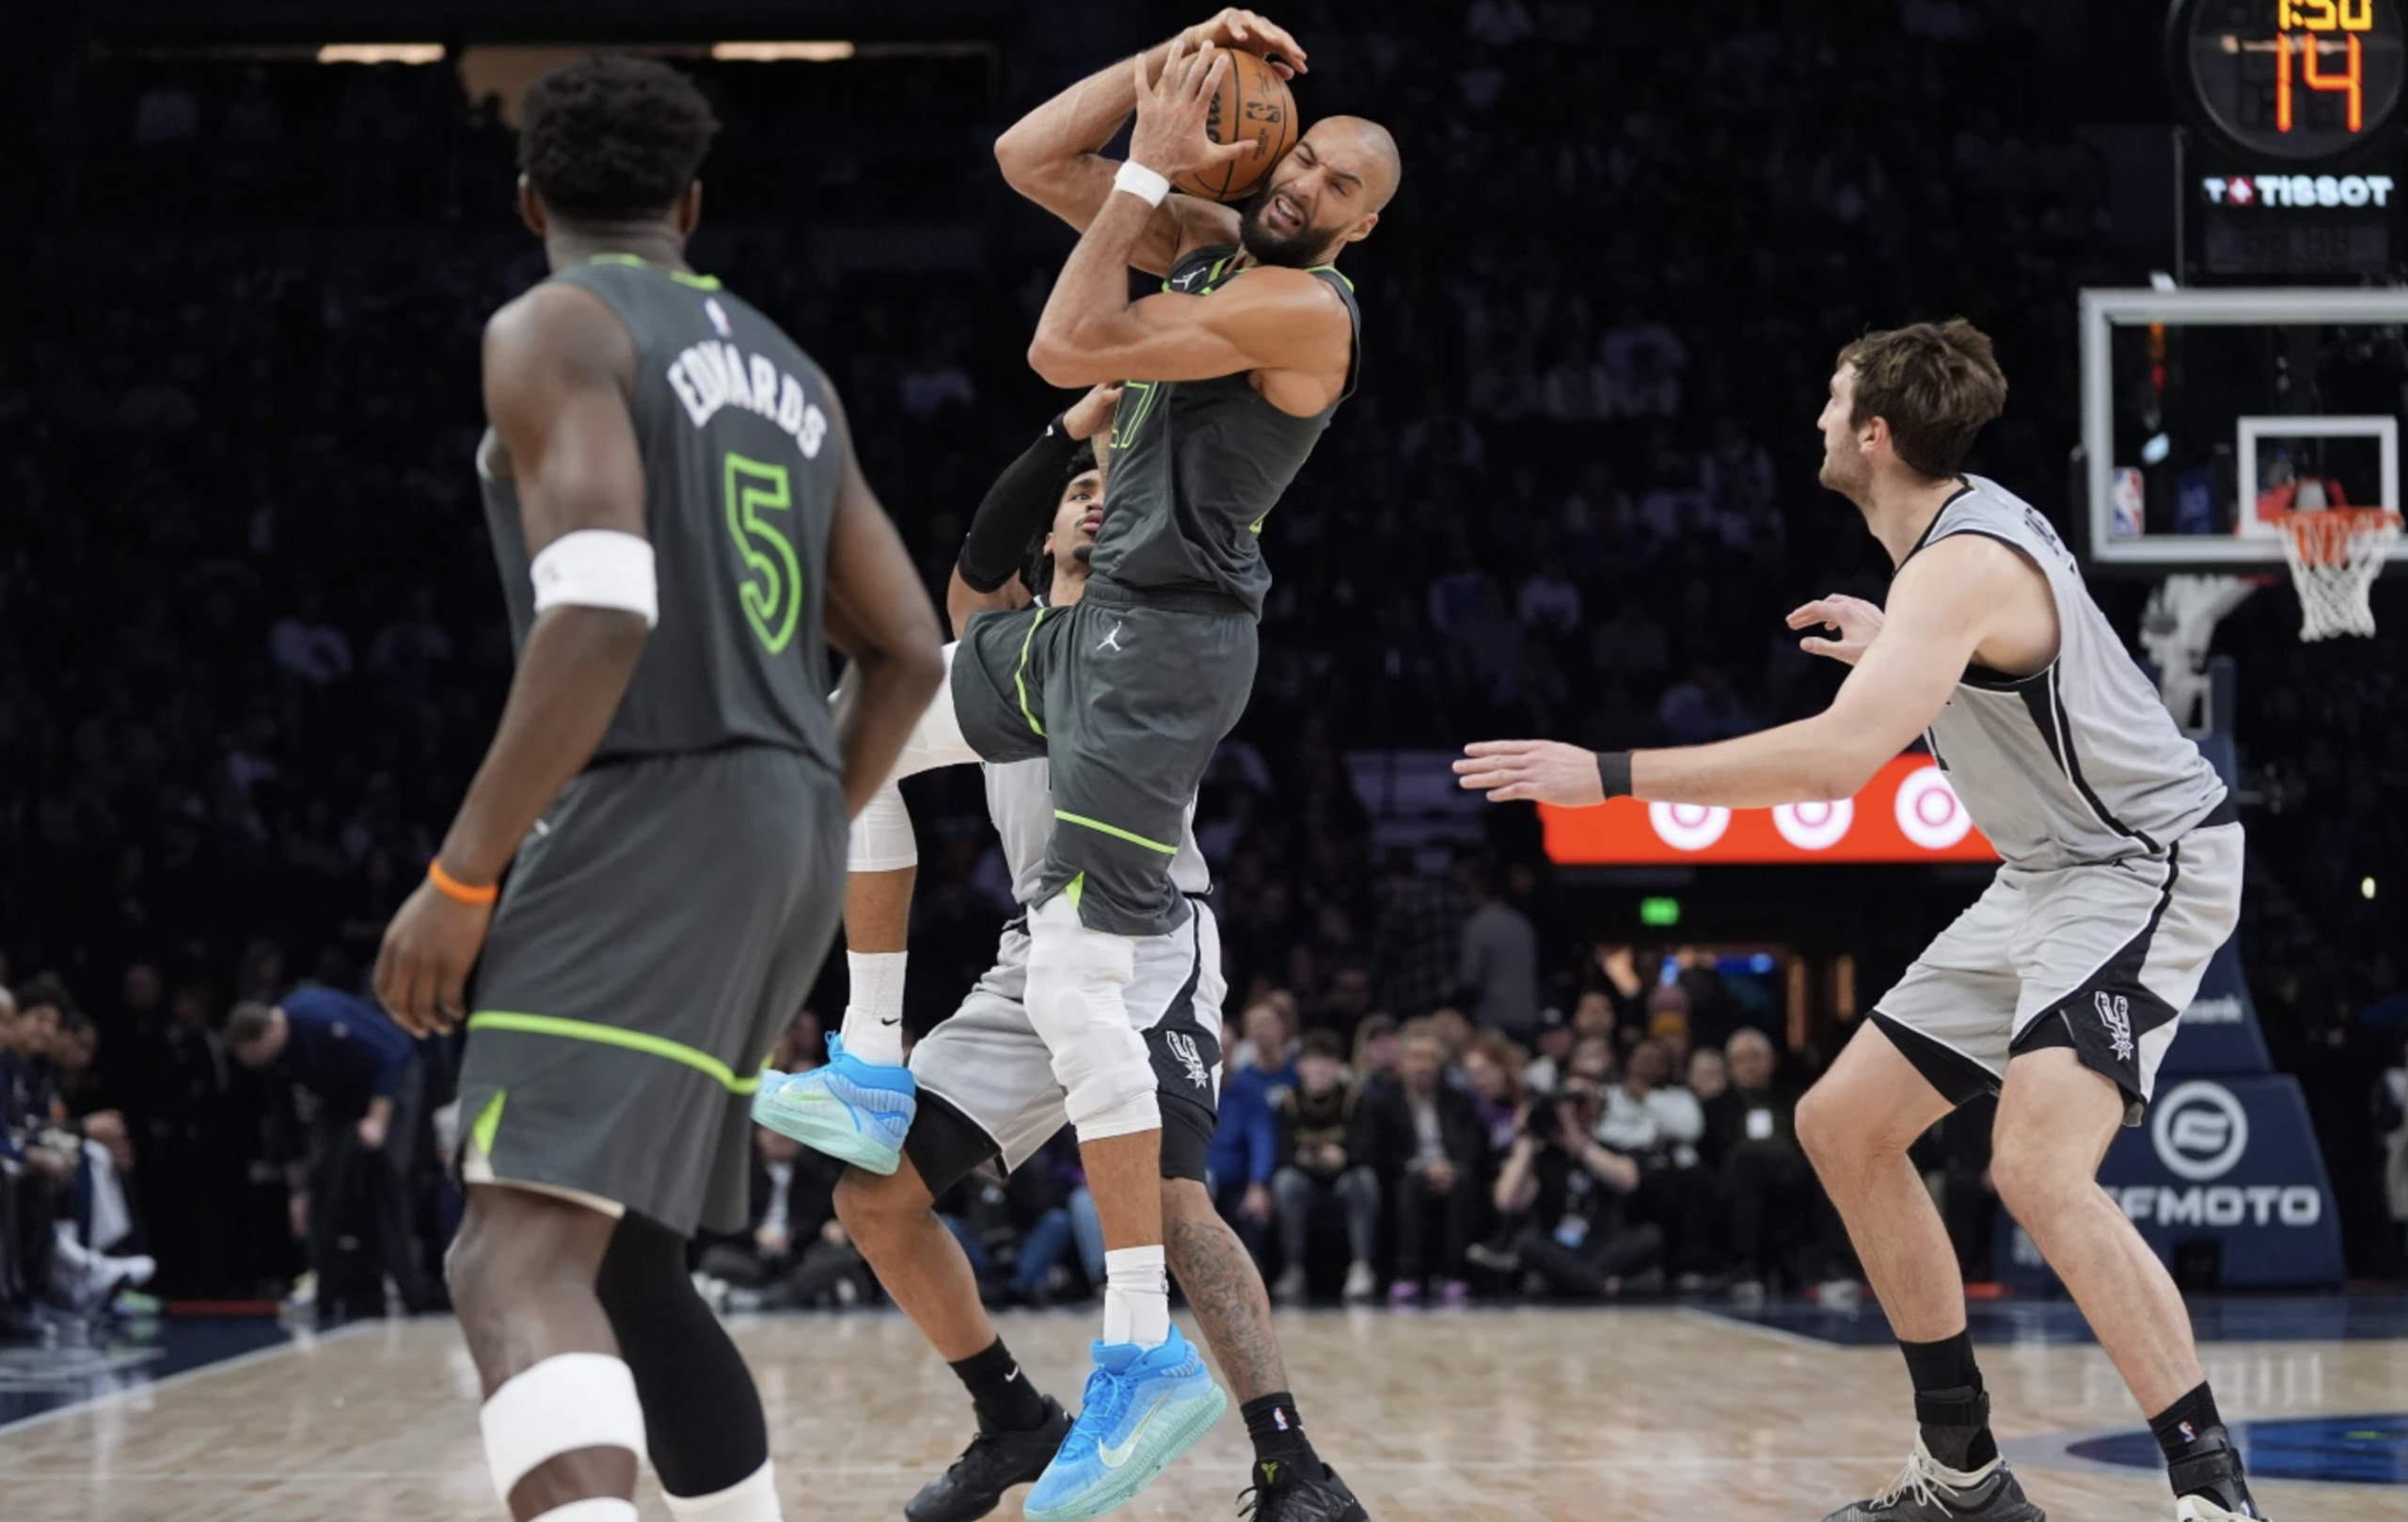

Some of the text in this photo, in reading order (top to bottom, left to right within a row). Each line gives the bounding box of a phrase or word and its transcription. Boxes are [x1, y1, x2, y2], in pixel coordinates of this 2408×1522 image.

[2276, 31, 2362, 133] 14
[2254, 174, 2394, 207] TISSOT
[667, 340, 827, 459] EDWARDS
[1110, 379, 1158, 449] 7
[724, 452, 801, 655] 5
[2105, 1185, 2321, 1227] FMOTO
